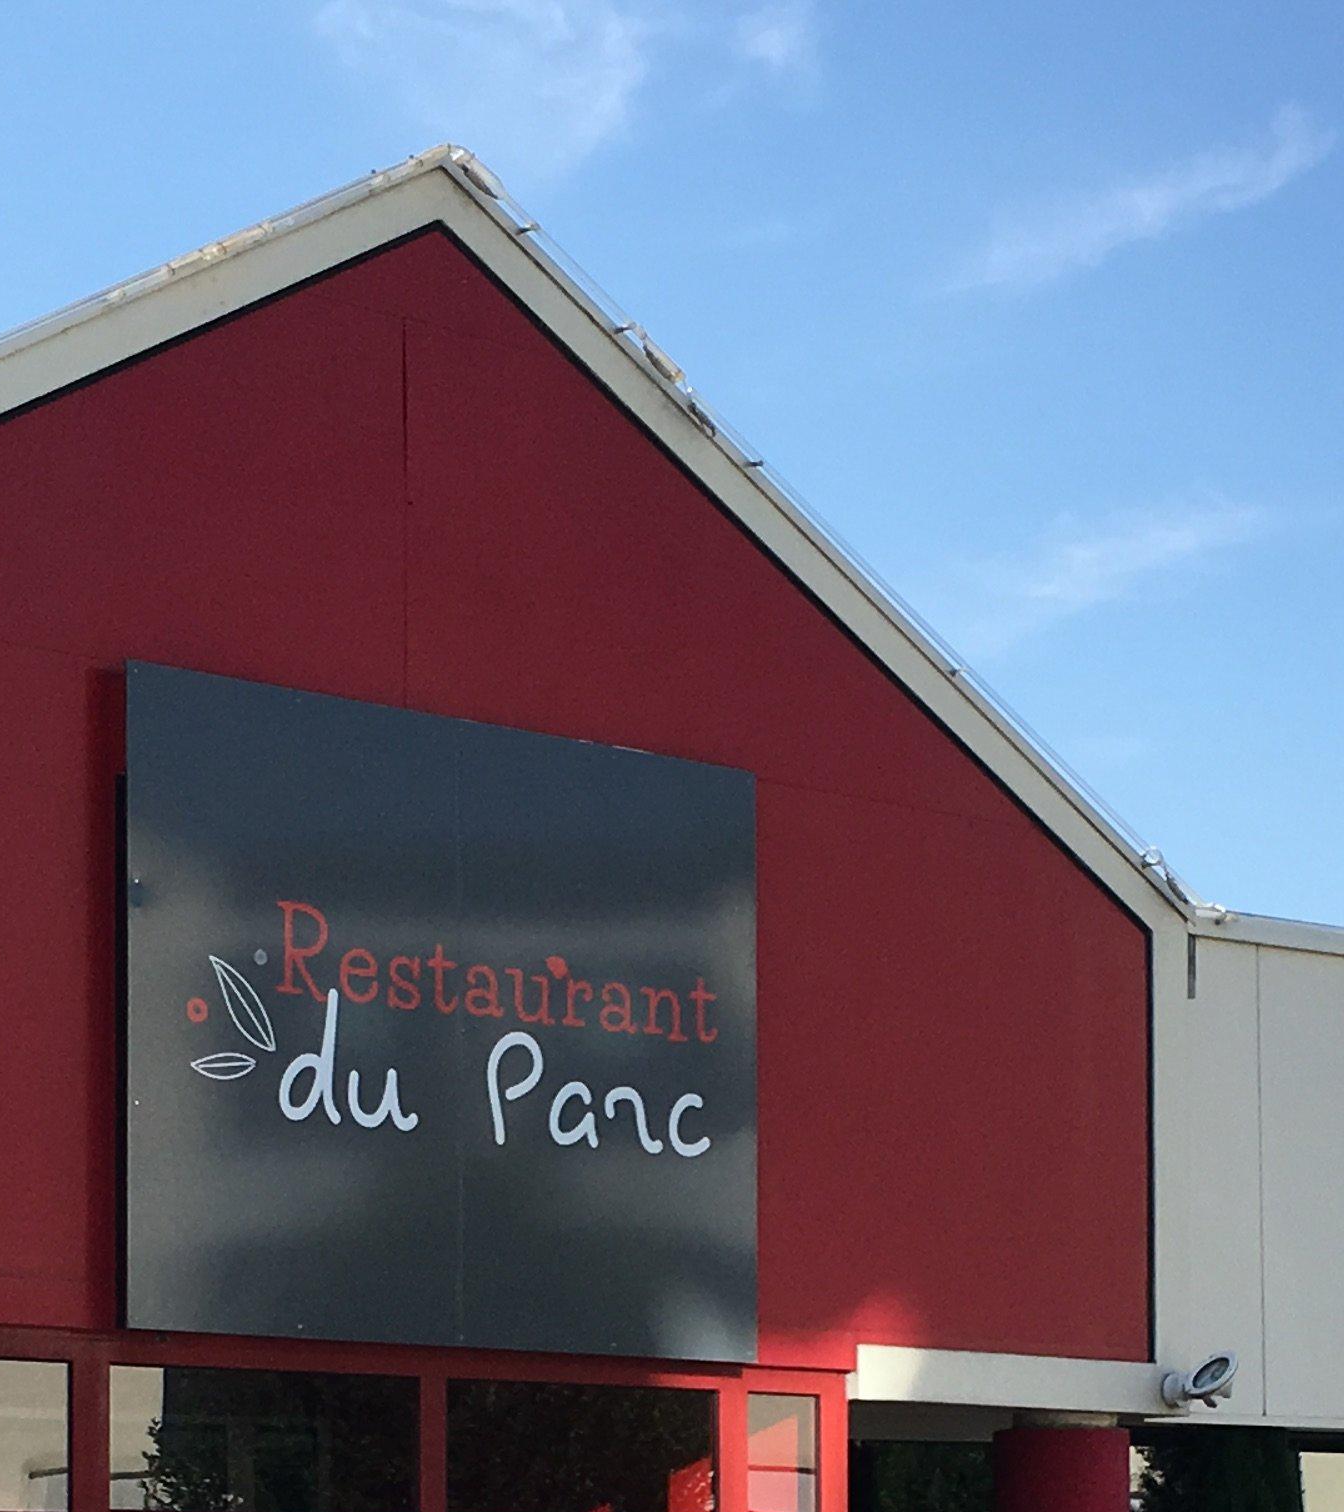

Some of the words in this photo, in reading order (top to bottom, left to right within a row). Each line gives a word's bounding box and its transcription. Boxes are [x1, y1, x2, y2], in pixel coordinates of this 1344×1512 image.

[275, 899, 718, 1045] Restaurant
[278, 987, 419, 1133] du
[487, 1031, 711, 1157] Parc
